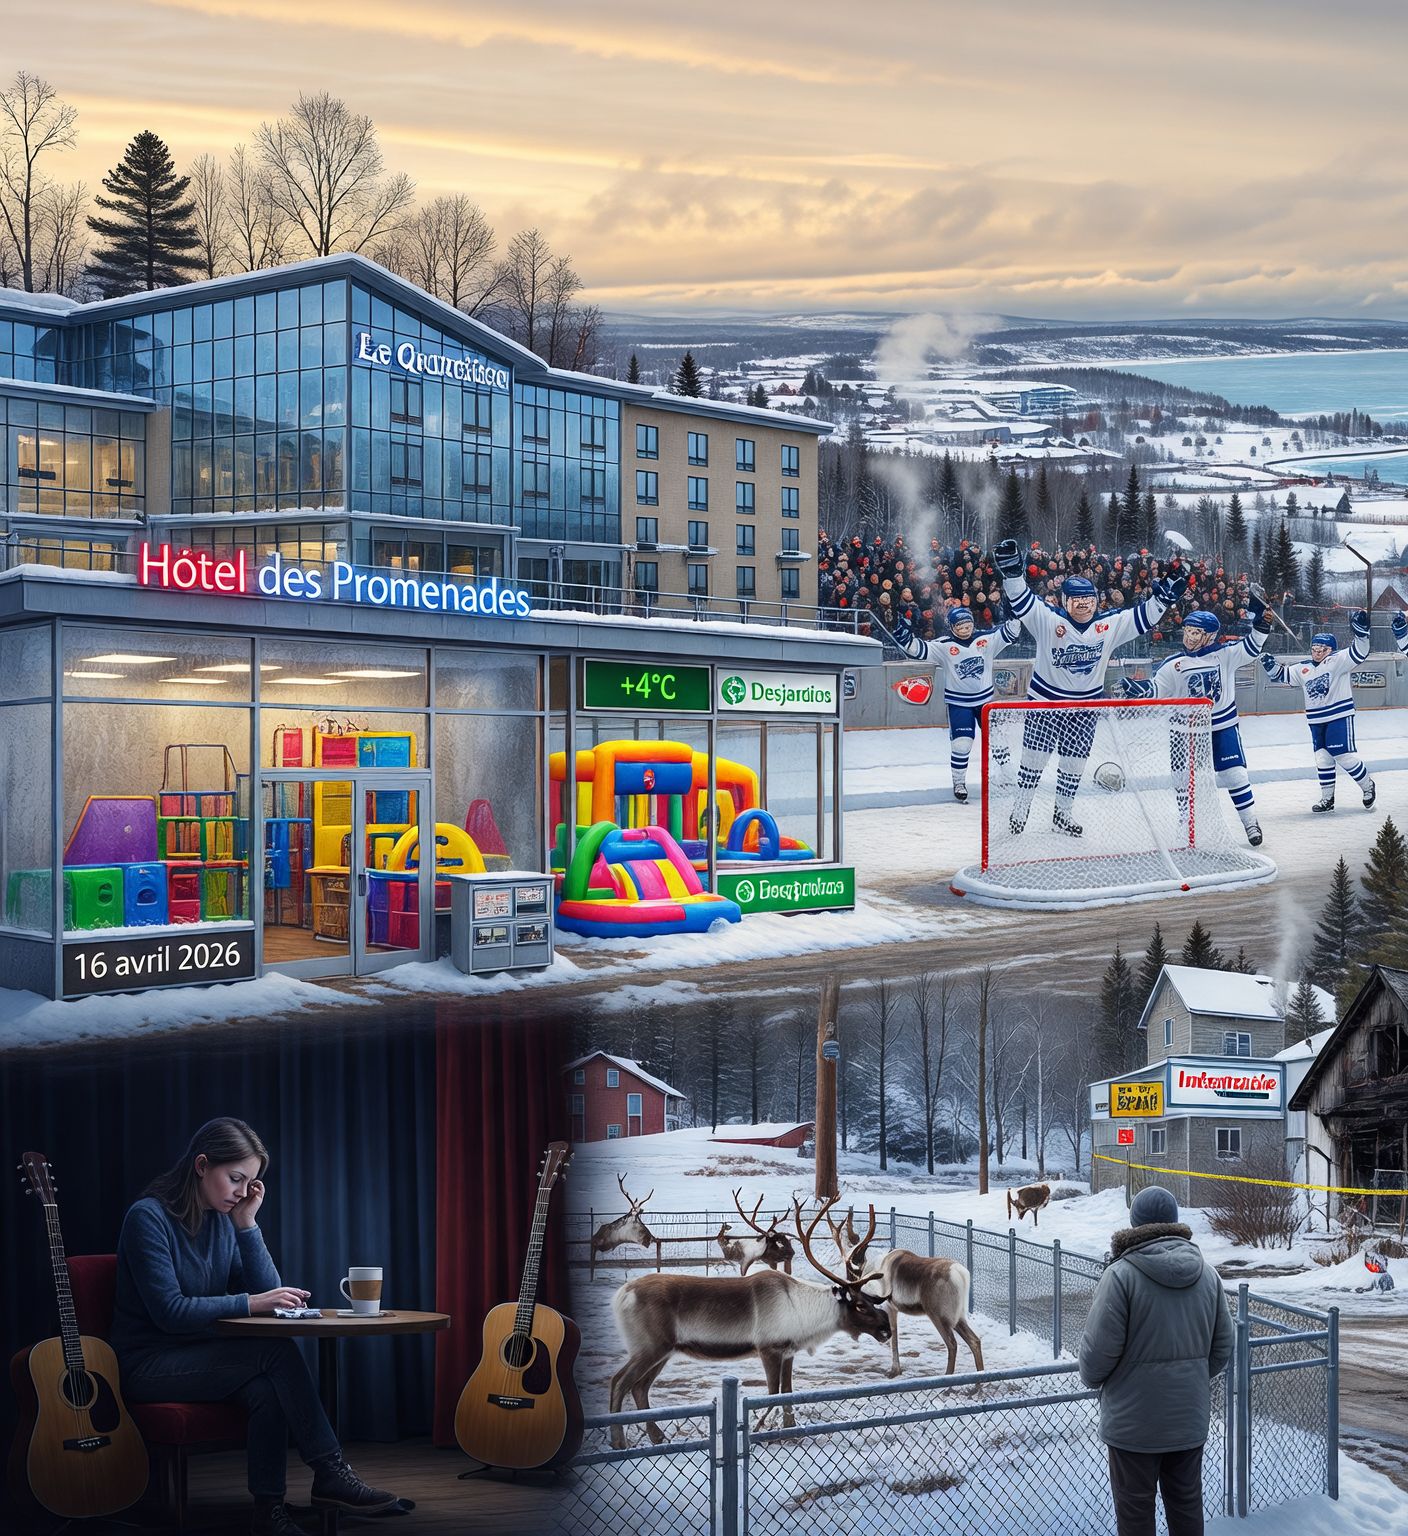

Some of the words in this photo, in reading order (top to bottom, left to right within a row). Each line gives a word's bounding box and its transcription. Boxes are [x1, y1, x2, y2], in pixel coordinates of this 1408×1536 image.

[258, 551, 323, 599] des
[333, 561, 531, 617] Promenades
[620, 671, 677, 700] +4°C
[74, 951, 108, 980] 16
[115, 945, 170, 976] avril
[178, 941, 241, 971] 2026
